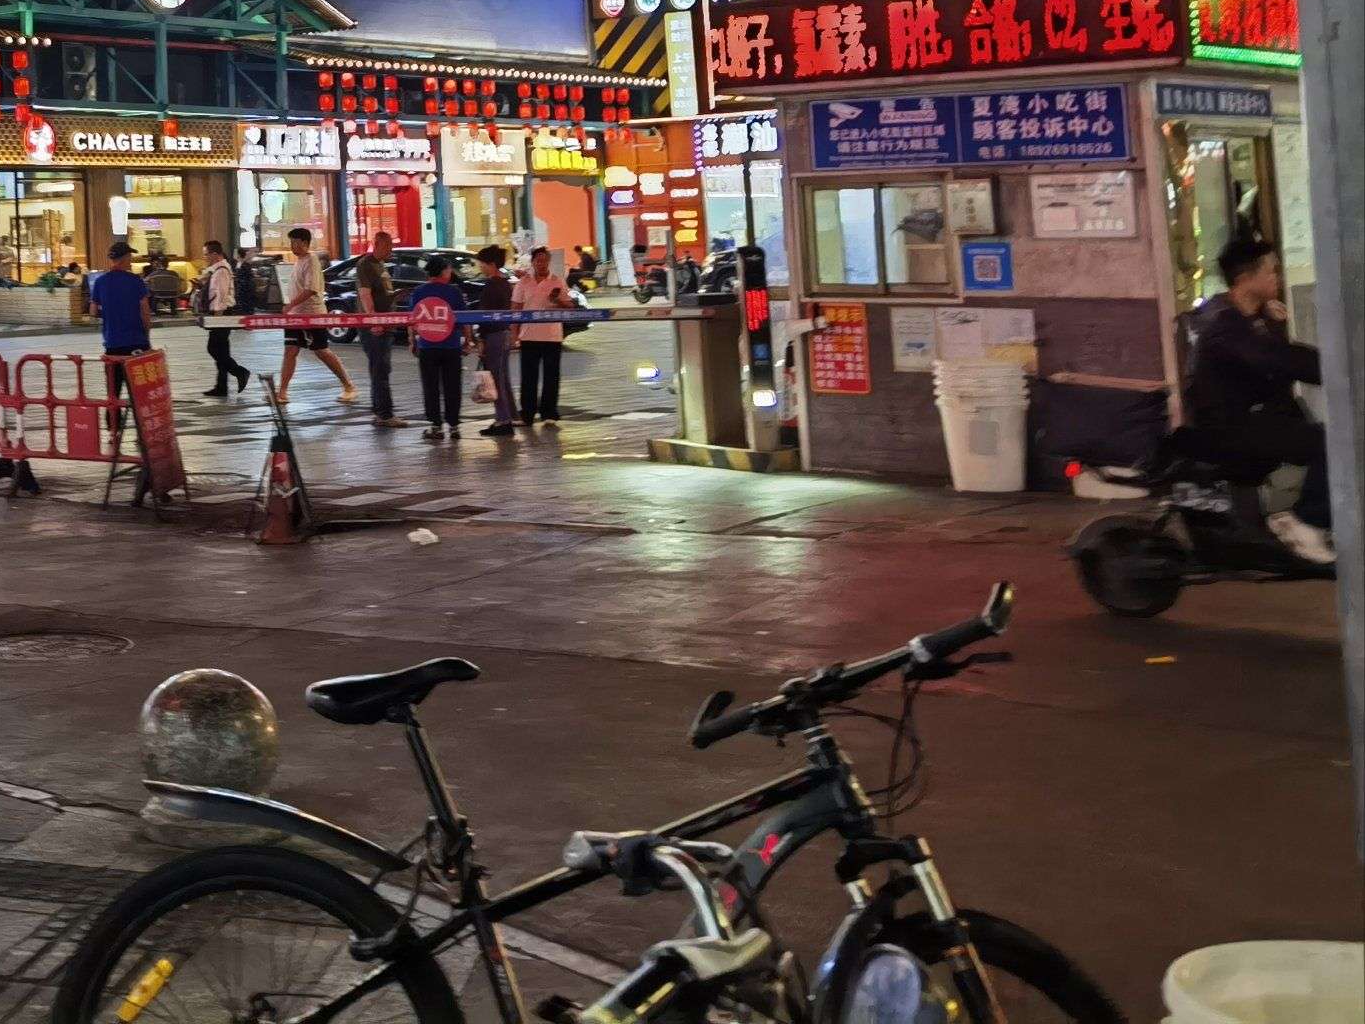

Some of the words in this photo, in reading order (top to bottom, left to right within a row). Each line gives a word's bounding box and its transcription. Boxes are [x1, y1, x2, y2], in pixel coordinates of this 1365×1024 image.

[970, 89, 1109, 118] 夏湾小吃街
[971, 114, 1116, 142] 顾客投诉中心
[72, 131, 155, 153] CHAGEE
[415, 304, 450, 322] 入口
